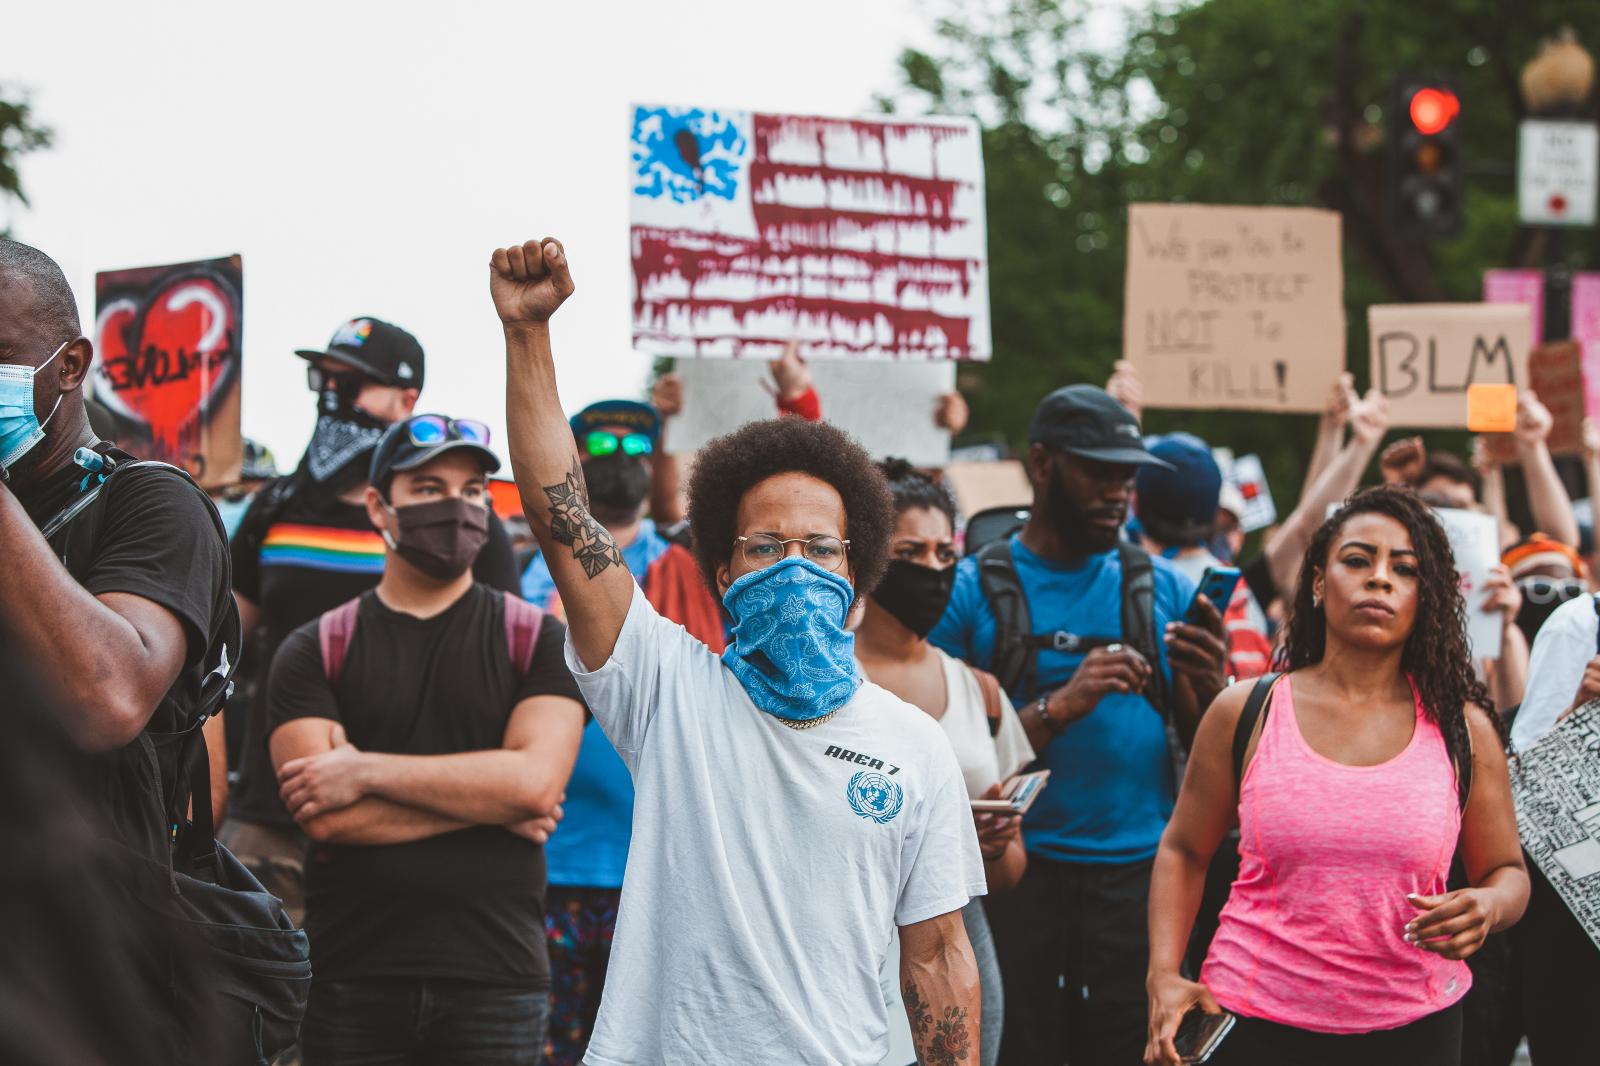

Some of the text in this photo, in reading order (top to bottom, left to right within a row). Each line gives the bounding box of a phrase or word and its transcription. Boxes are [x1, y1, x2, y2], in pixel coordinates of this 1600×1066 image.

[1136, 216, 1189, 262] We
[1188, 268, 1311, 304] PROTECT
[1146, 308, 1220, 350] NOT
[1188, 359, 1287, 402] KILL!
[1378, 331, 1516, 397] BLM
[824, 745, 901, 775] AREA 7
